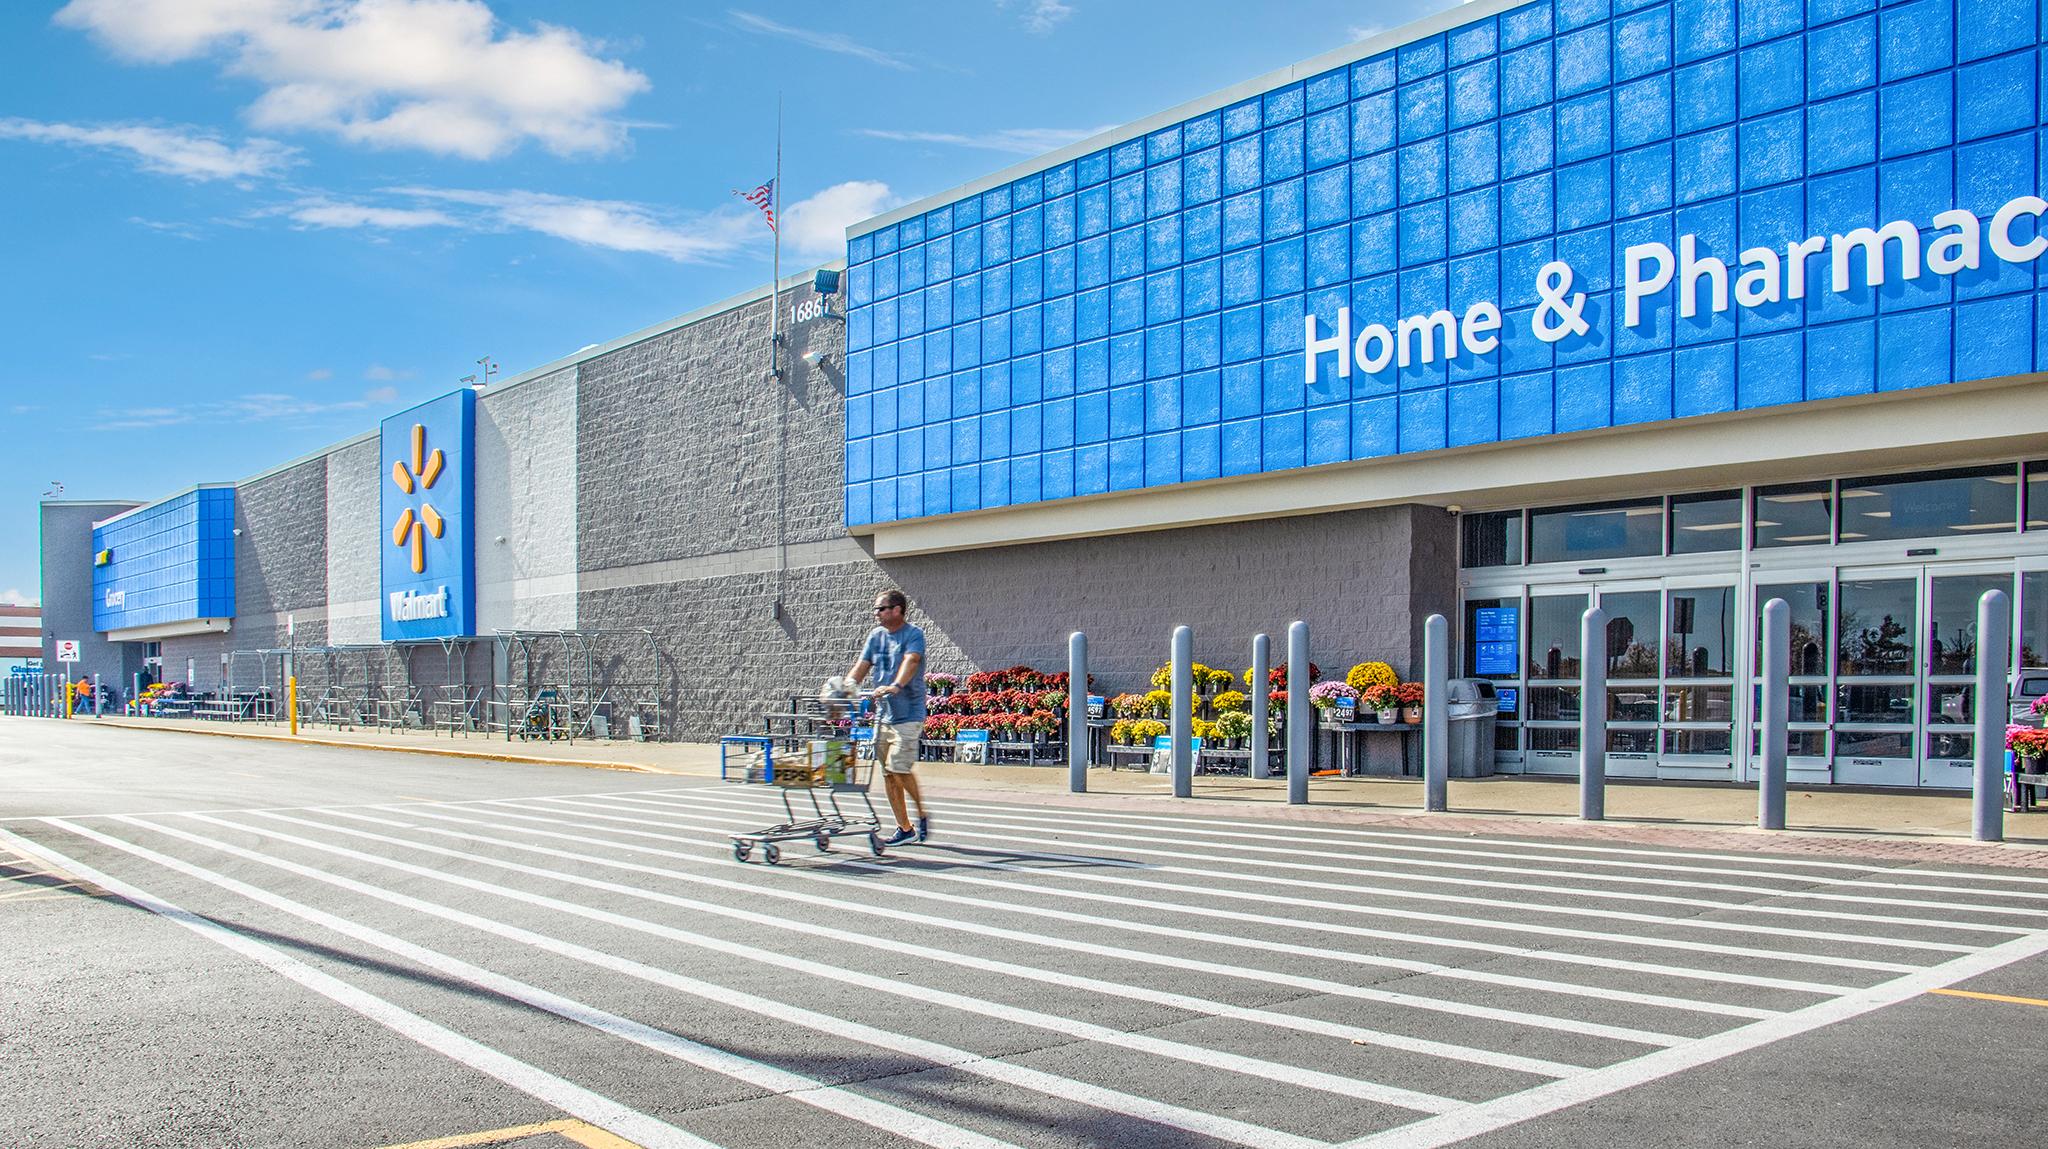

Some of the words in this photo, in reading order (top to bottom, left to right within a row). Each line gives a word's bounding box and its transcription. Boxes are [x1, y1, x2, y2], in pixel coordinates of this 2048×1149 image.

[1305, 301, 1502, 384] Home
[1531, 260, 1590, 343] &
[1624, 195, 2048, 328] Pharmac
[1904, 501, 1957, 513] Welcome
[390, 585, 448, 622] Walmart
